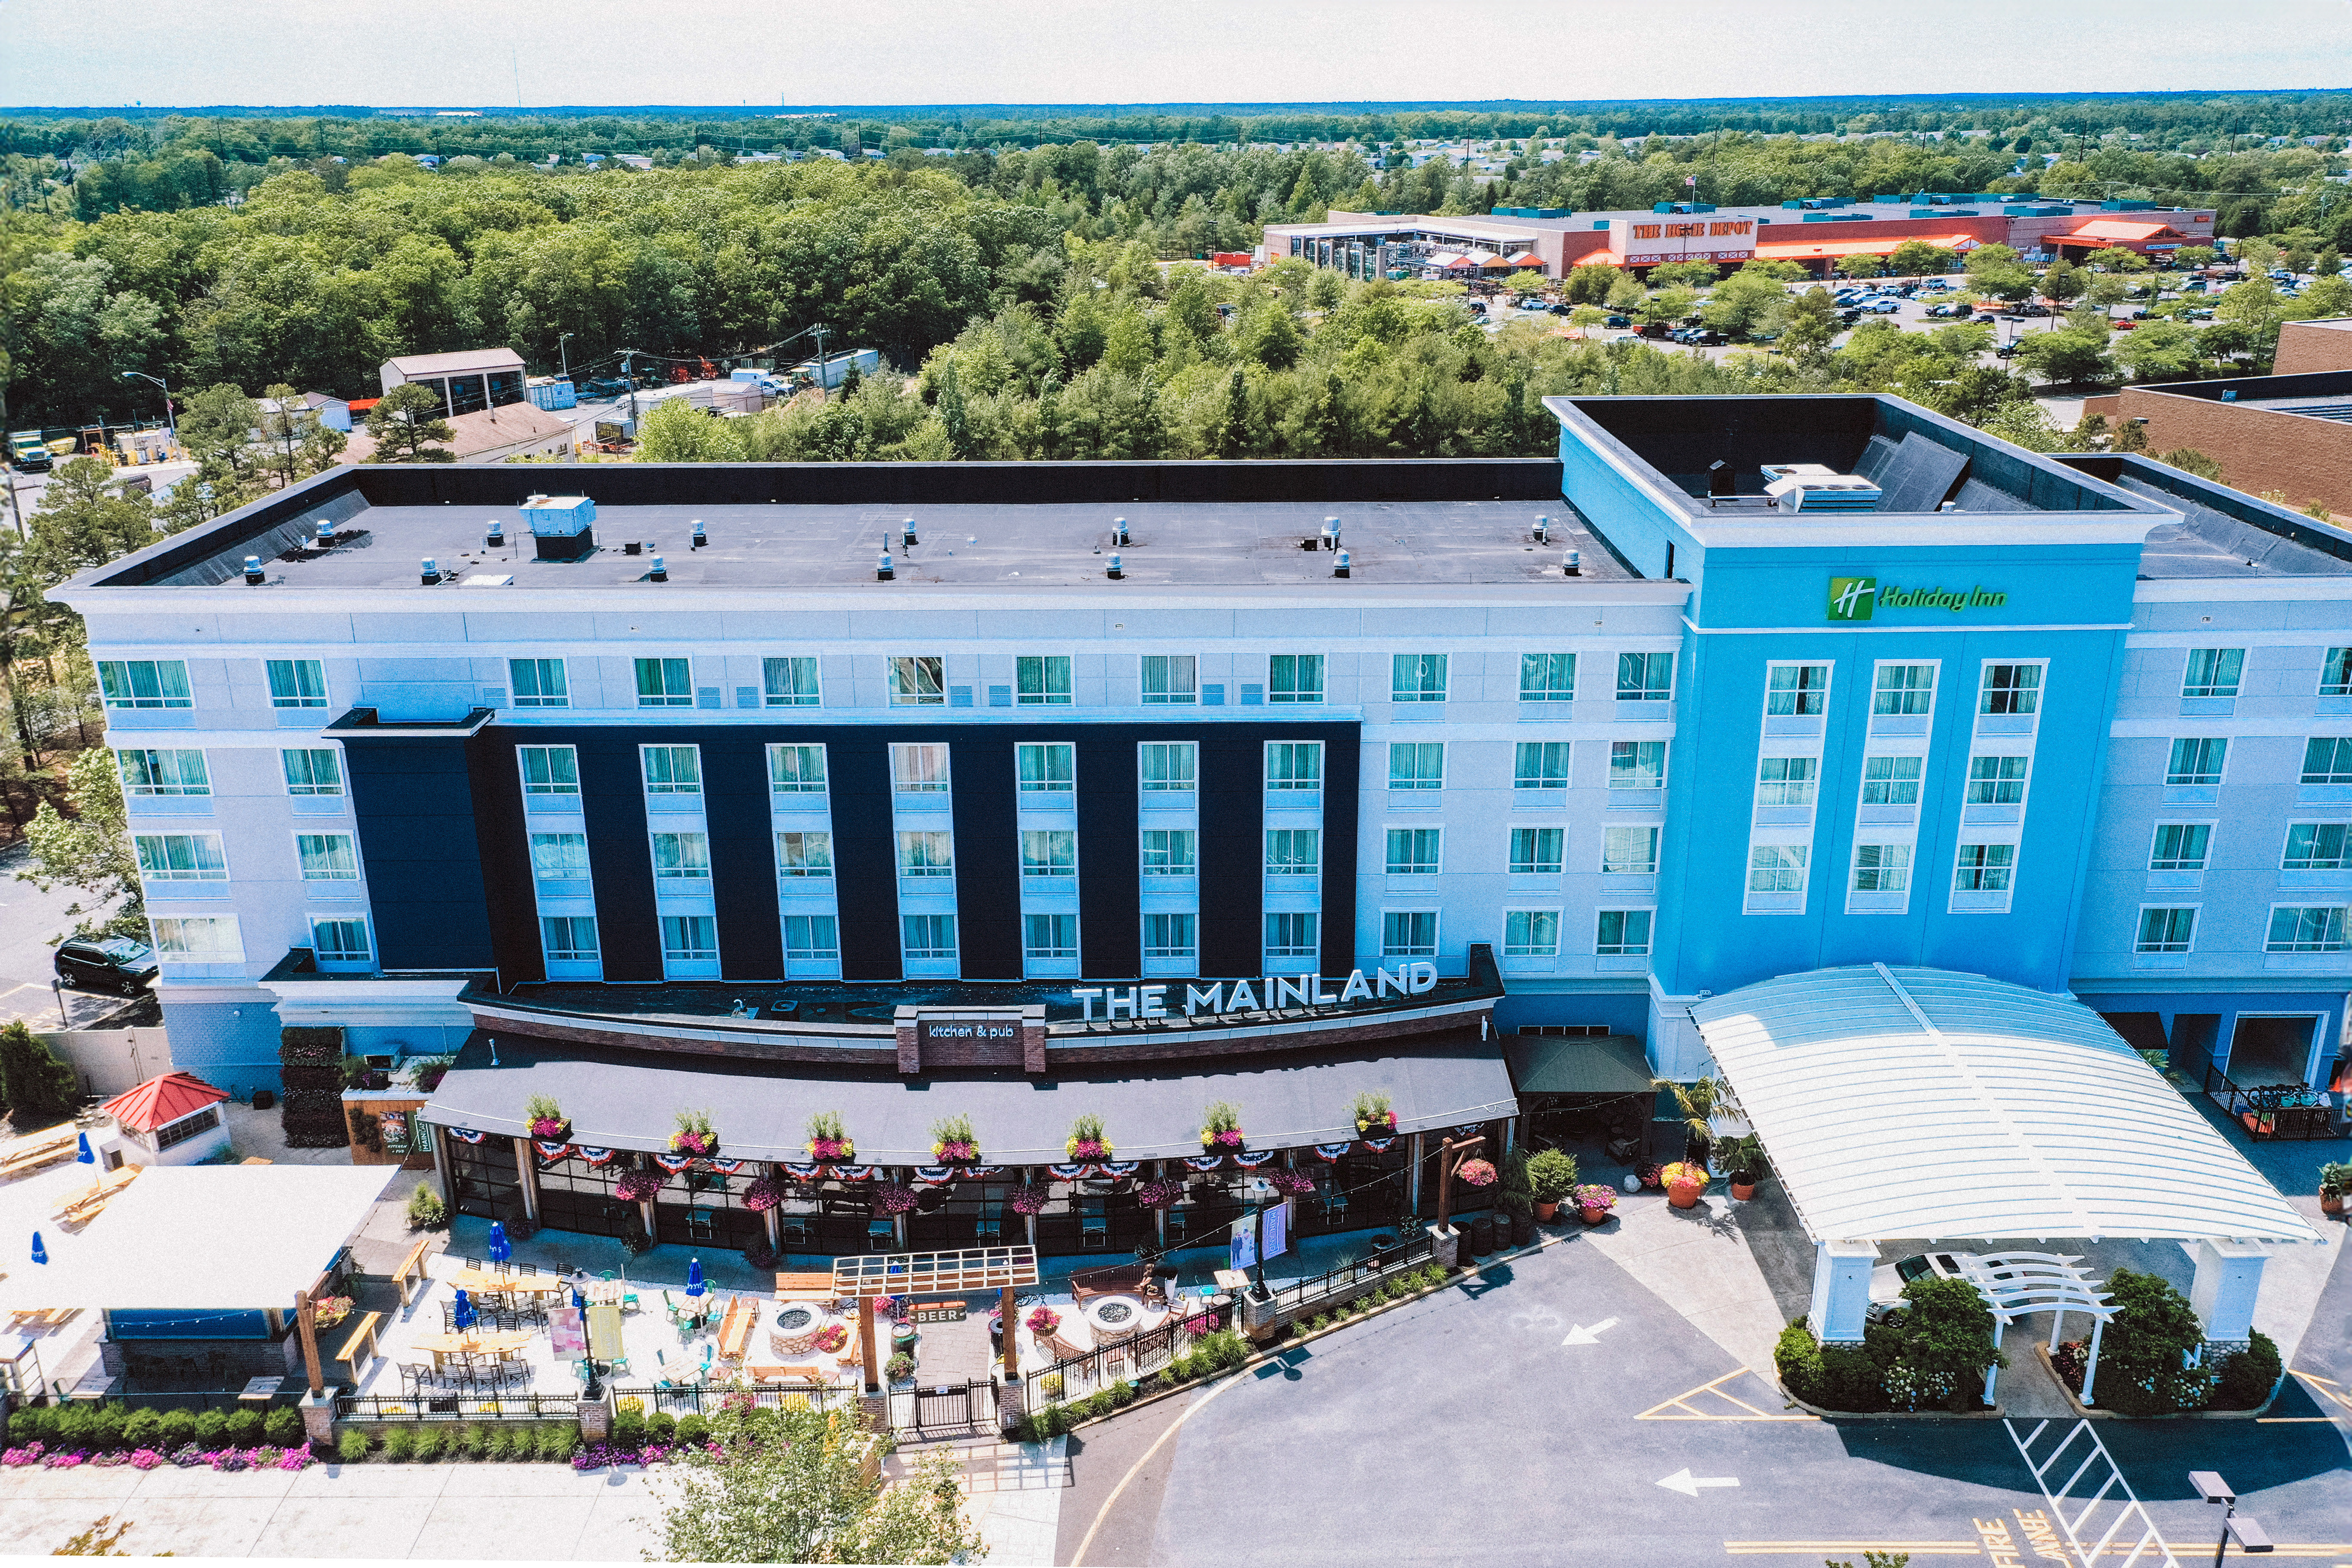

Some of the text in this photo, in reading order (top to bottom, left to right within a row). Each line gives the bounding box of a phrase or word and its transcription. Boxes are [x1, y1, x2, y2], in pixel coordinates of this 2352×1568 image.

[1633, 221, 1753, 239] THE HOME DEPOT
[597, 429, 619, 438] CAUTION
[1879, 586, 1969, 612] Holiday
[1969, 585, 2008, 606] Inn
[1072, 962, 1438, 1021] THE MAINLAND
[929, 1024, 1014, 1039] kitchen & pub
[419, 1122, 429, 1150] MAINLAN
[918, 1310, 958, 1322] BEER
[1972, 1518, 2026, 1568] FIRE
